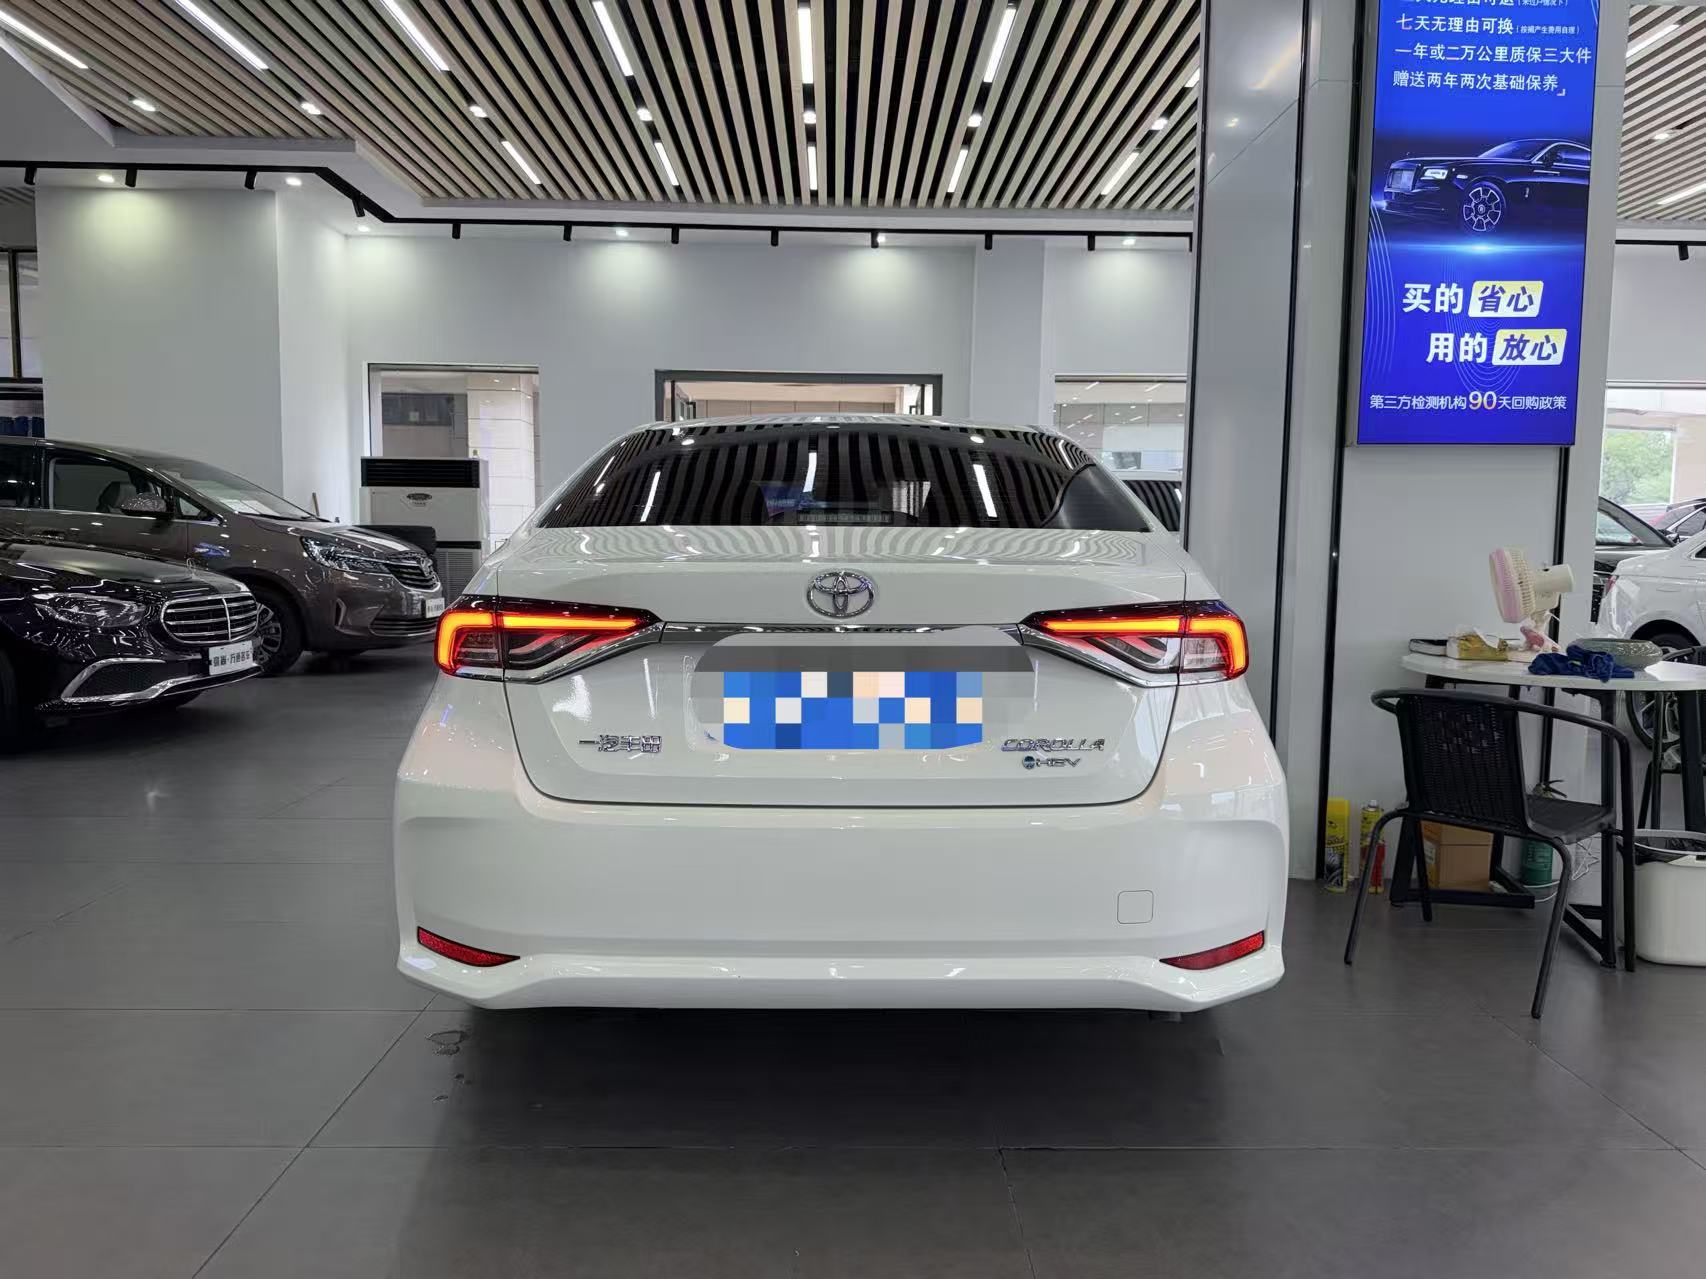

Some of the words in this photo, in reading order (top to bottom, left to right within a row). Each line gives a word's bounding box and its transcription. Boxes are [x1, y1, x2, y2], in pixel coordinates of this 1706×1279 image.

[1396, 13, 1514, 35] 七天无理由可换
[1395, 43, 1592, 64] 一年或二万公里质保三大件
[1403, 283, 1464, 314] 买的
[1478, 285, 1534, 312] 省心
[1426, 333, 1488, 363] 用的
[1499, 334, 1557, 361] 放心
[1369, 391, 1567, 410] 第三方检测机构90天回购政策
[579, 735, 662, 753] 一汽丰田
[1001, 738, 1105, 752] COROLLA
[1036, 758, 1081, 767] HEV
